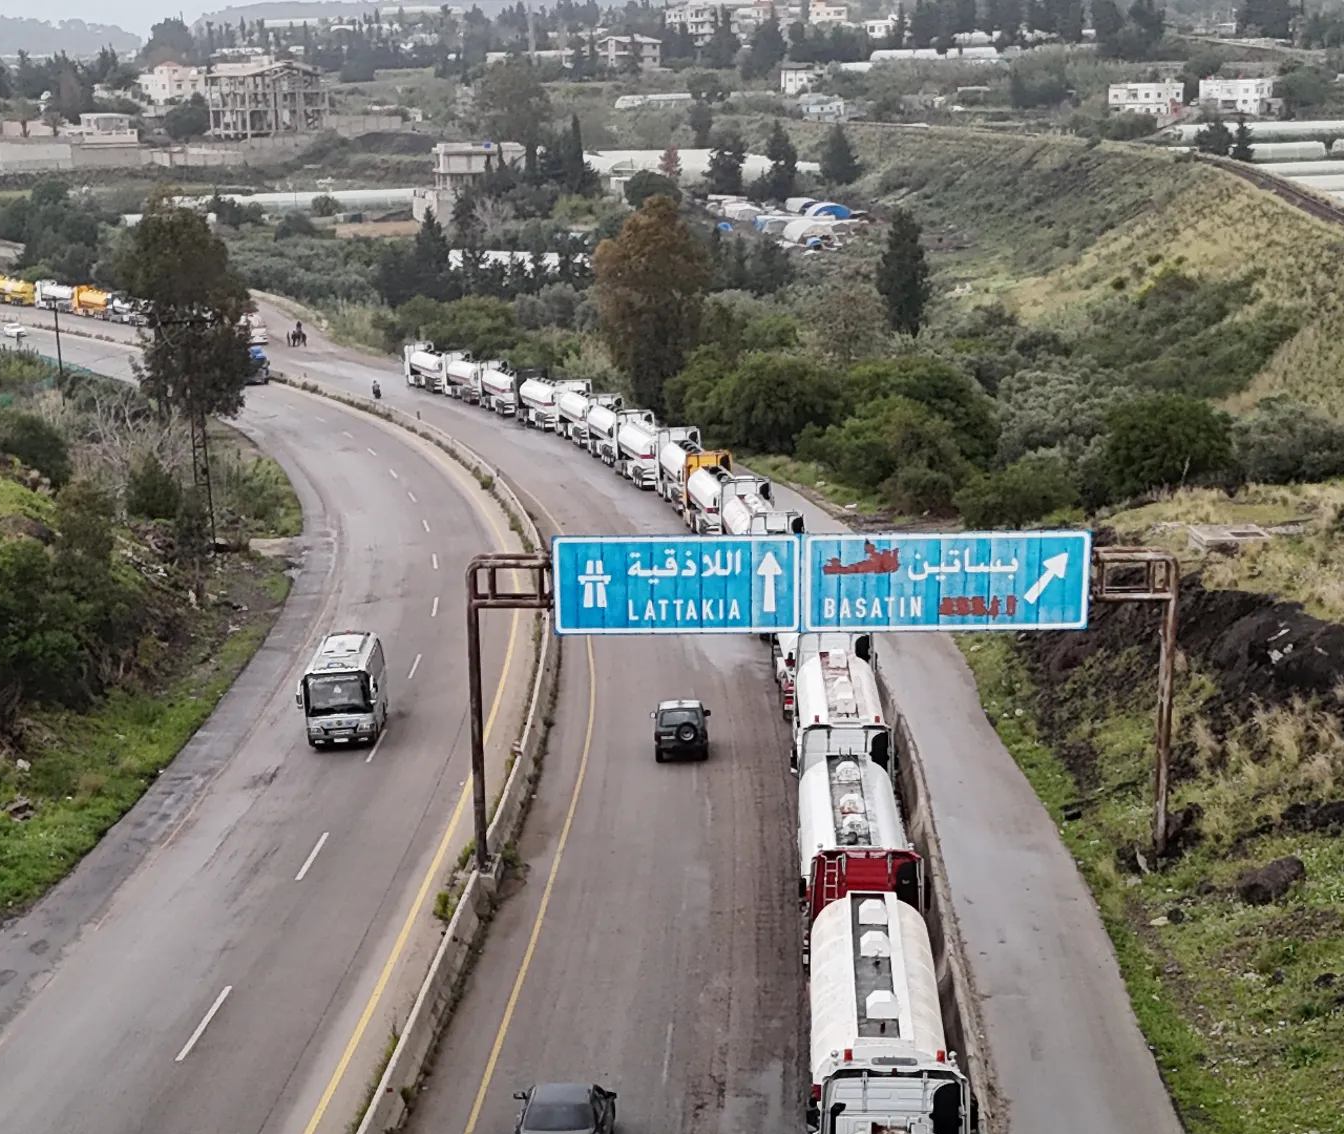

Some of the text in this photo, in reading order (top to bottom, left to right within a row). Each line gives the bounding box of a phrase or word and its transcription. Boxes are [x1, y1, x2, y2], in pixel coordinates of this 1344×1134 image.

[627, 548, 742, 584] اللاذقية
[907, 548, 1019, 581] بساتين
[628, 599, 741, 621] LATTAKIA
[823, 596, 923, 619] BASATIN
